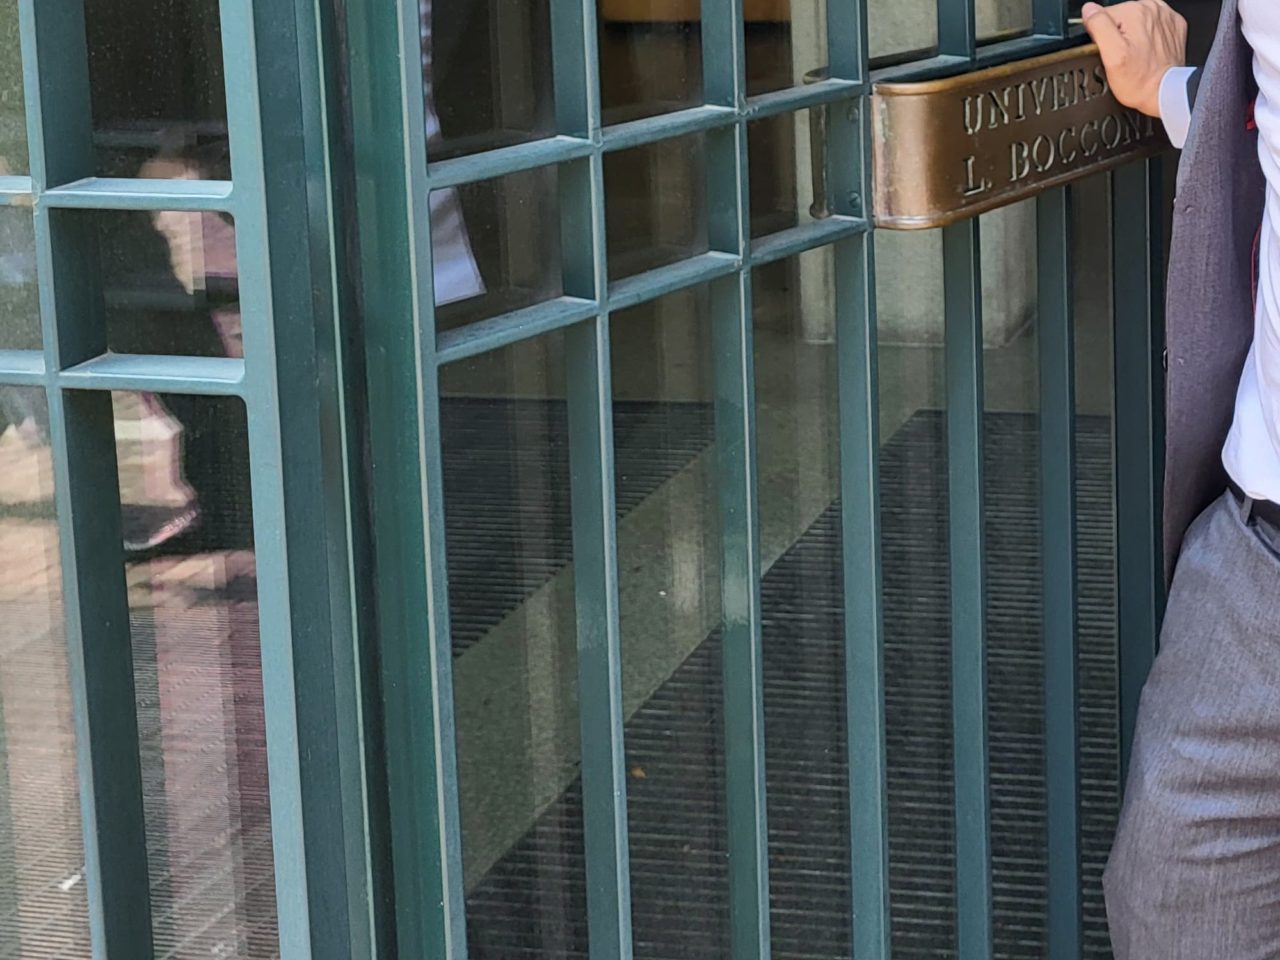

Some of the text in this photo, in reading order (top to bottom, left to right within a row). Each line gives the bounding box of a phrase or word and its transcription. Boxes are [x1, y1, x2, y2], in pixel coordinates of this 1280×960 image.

[961, 65, 1109, 135] UNIVERS
[962, 110, 1155, 197] L. BOCCONI
